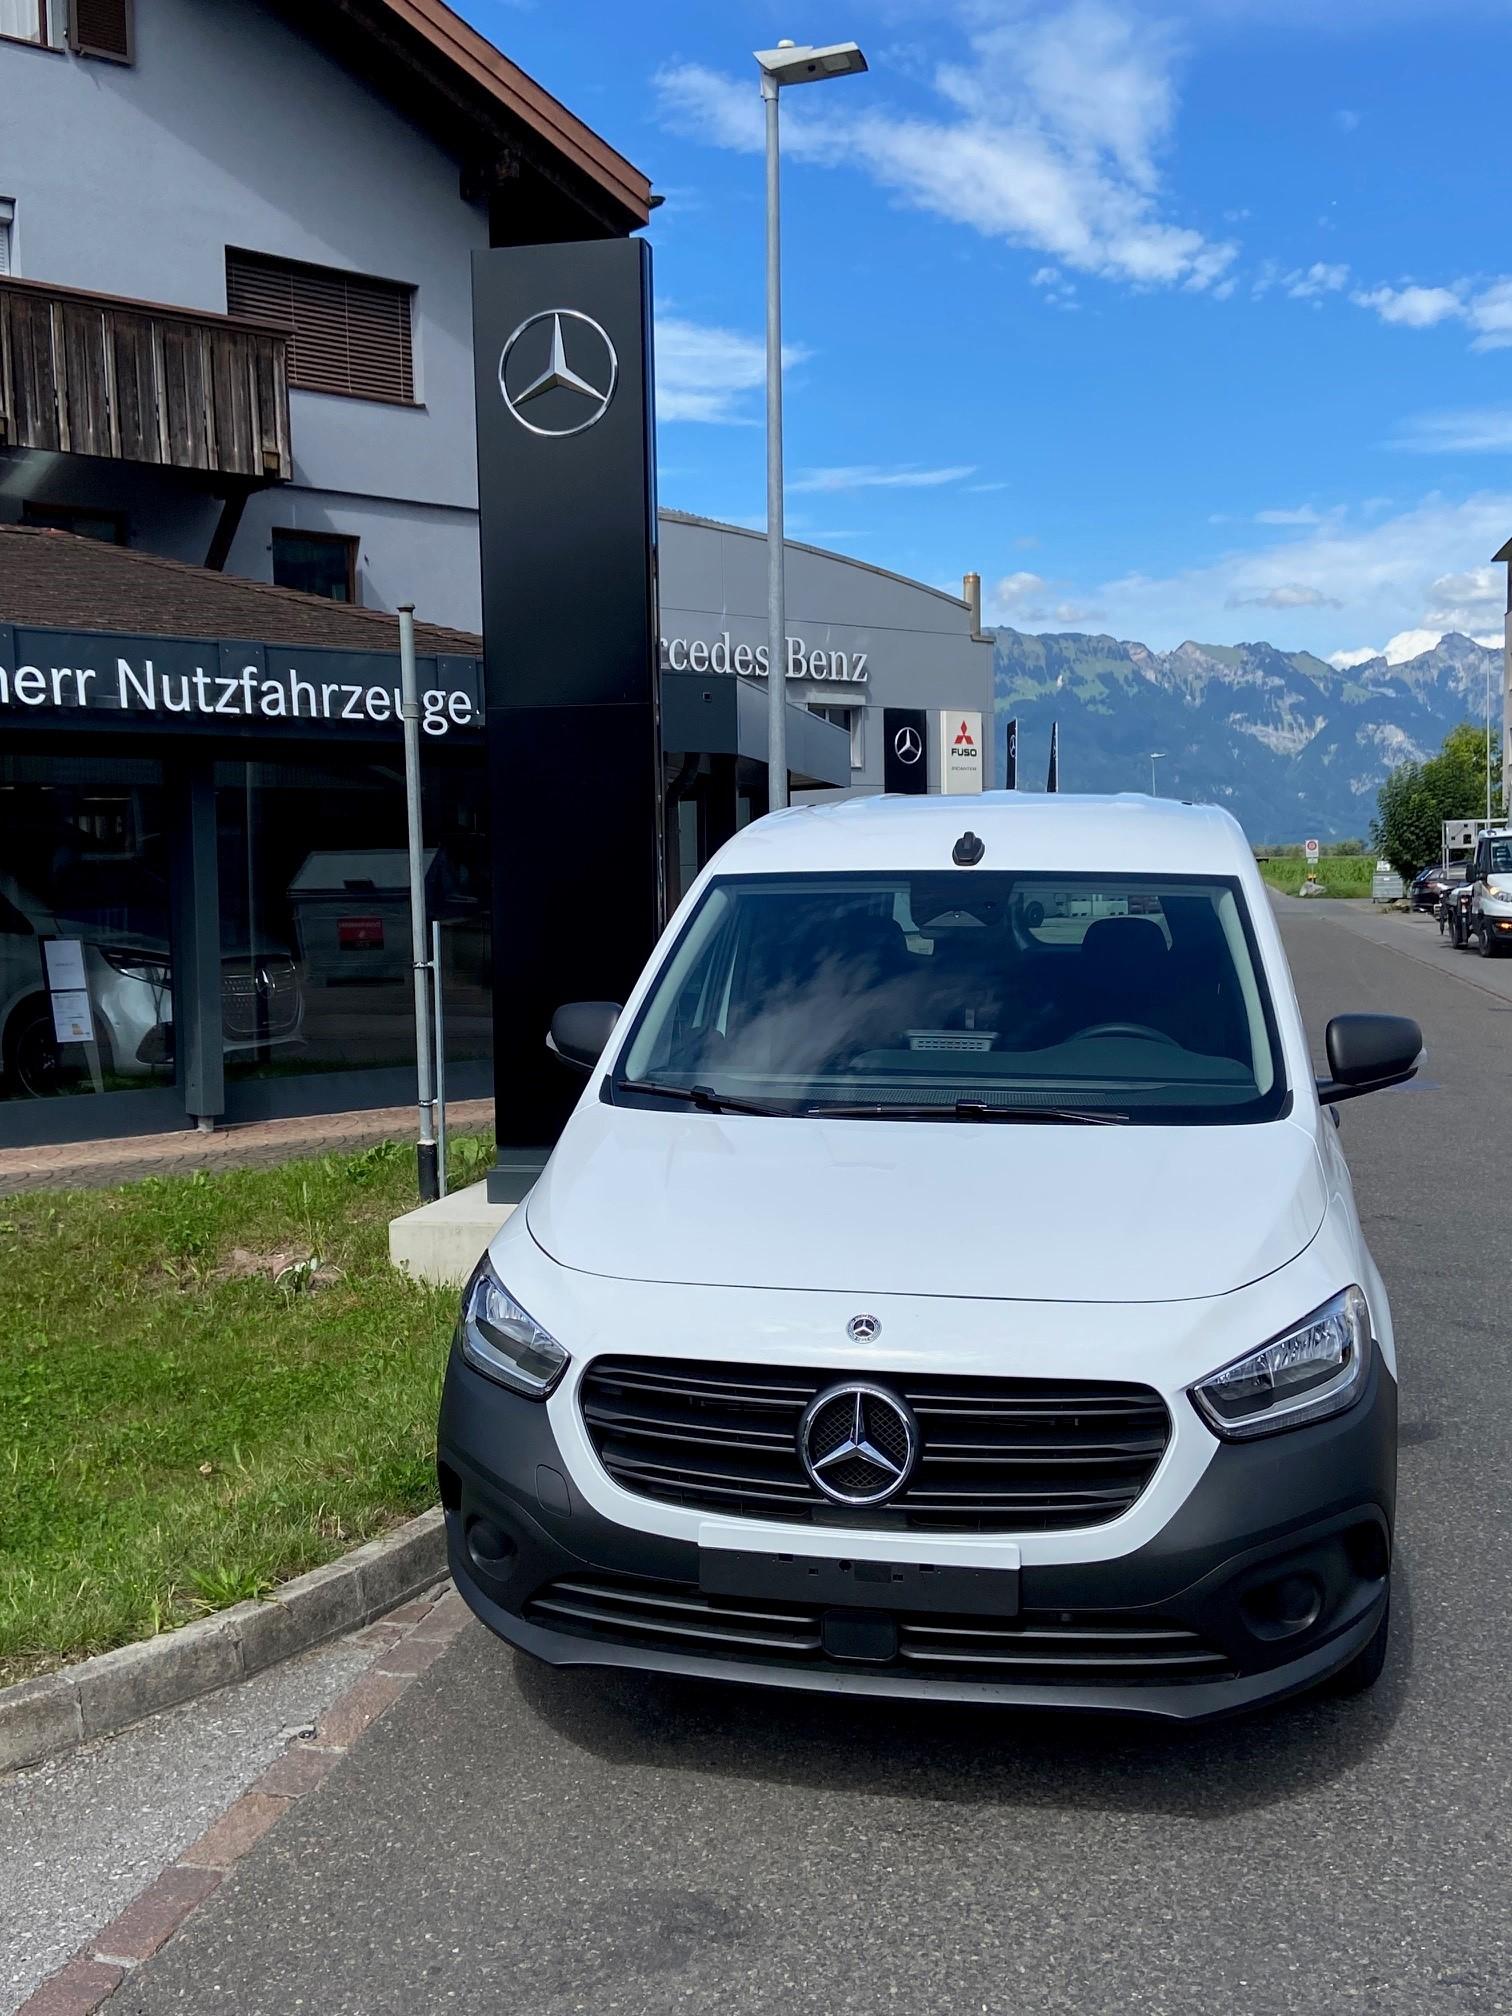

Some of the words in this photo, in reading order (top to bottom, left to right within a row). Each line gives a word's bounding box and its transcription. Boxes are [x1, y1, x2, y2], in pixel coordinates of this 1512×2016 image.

[785, 636, 868, 682] Benz
[117, 657, 472, 735] Nutzfahrzeuge
[951, 748, 977, 757] FUSO
